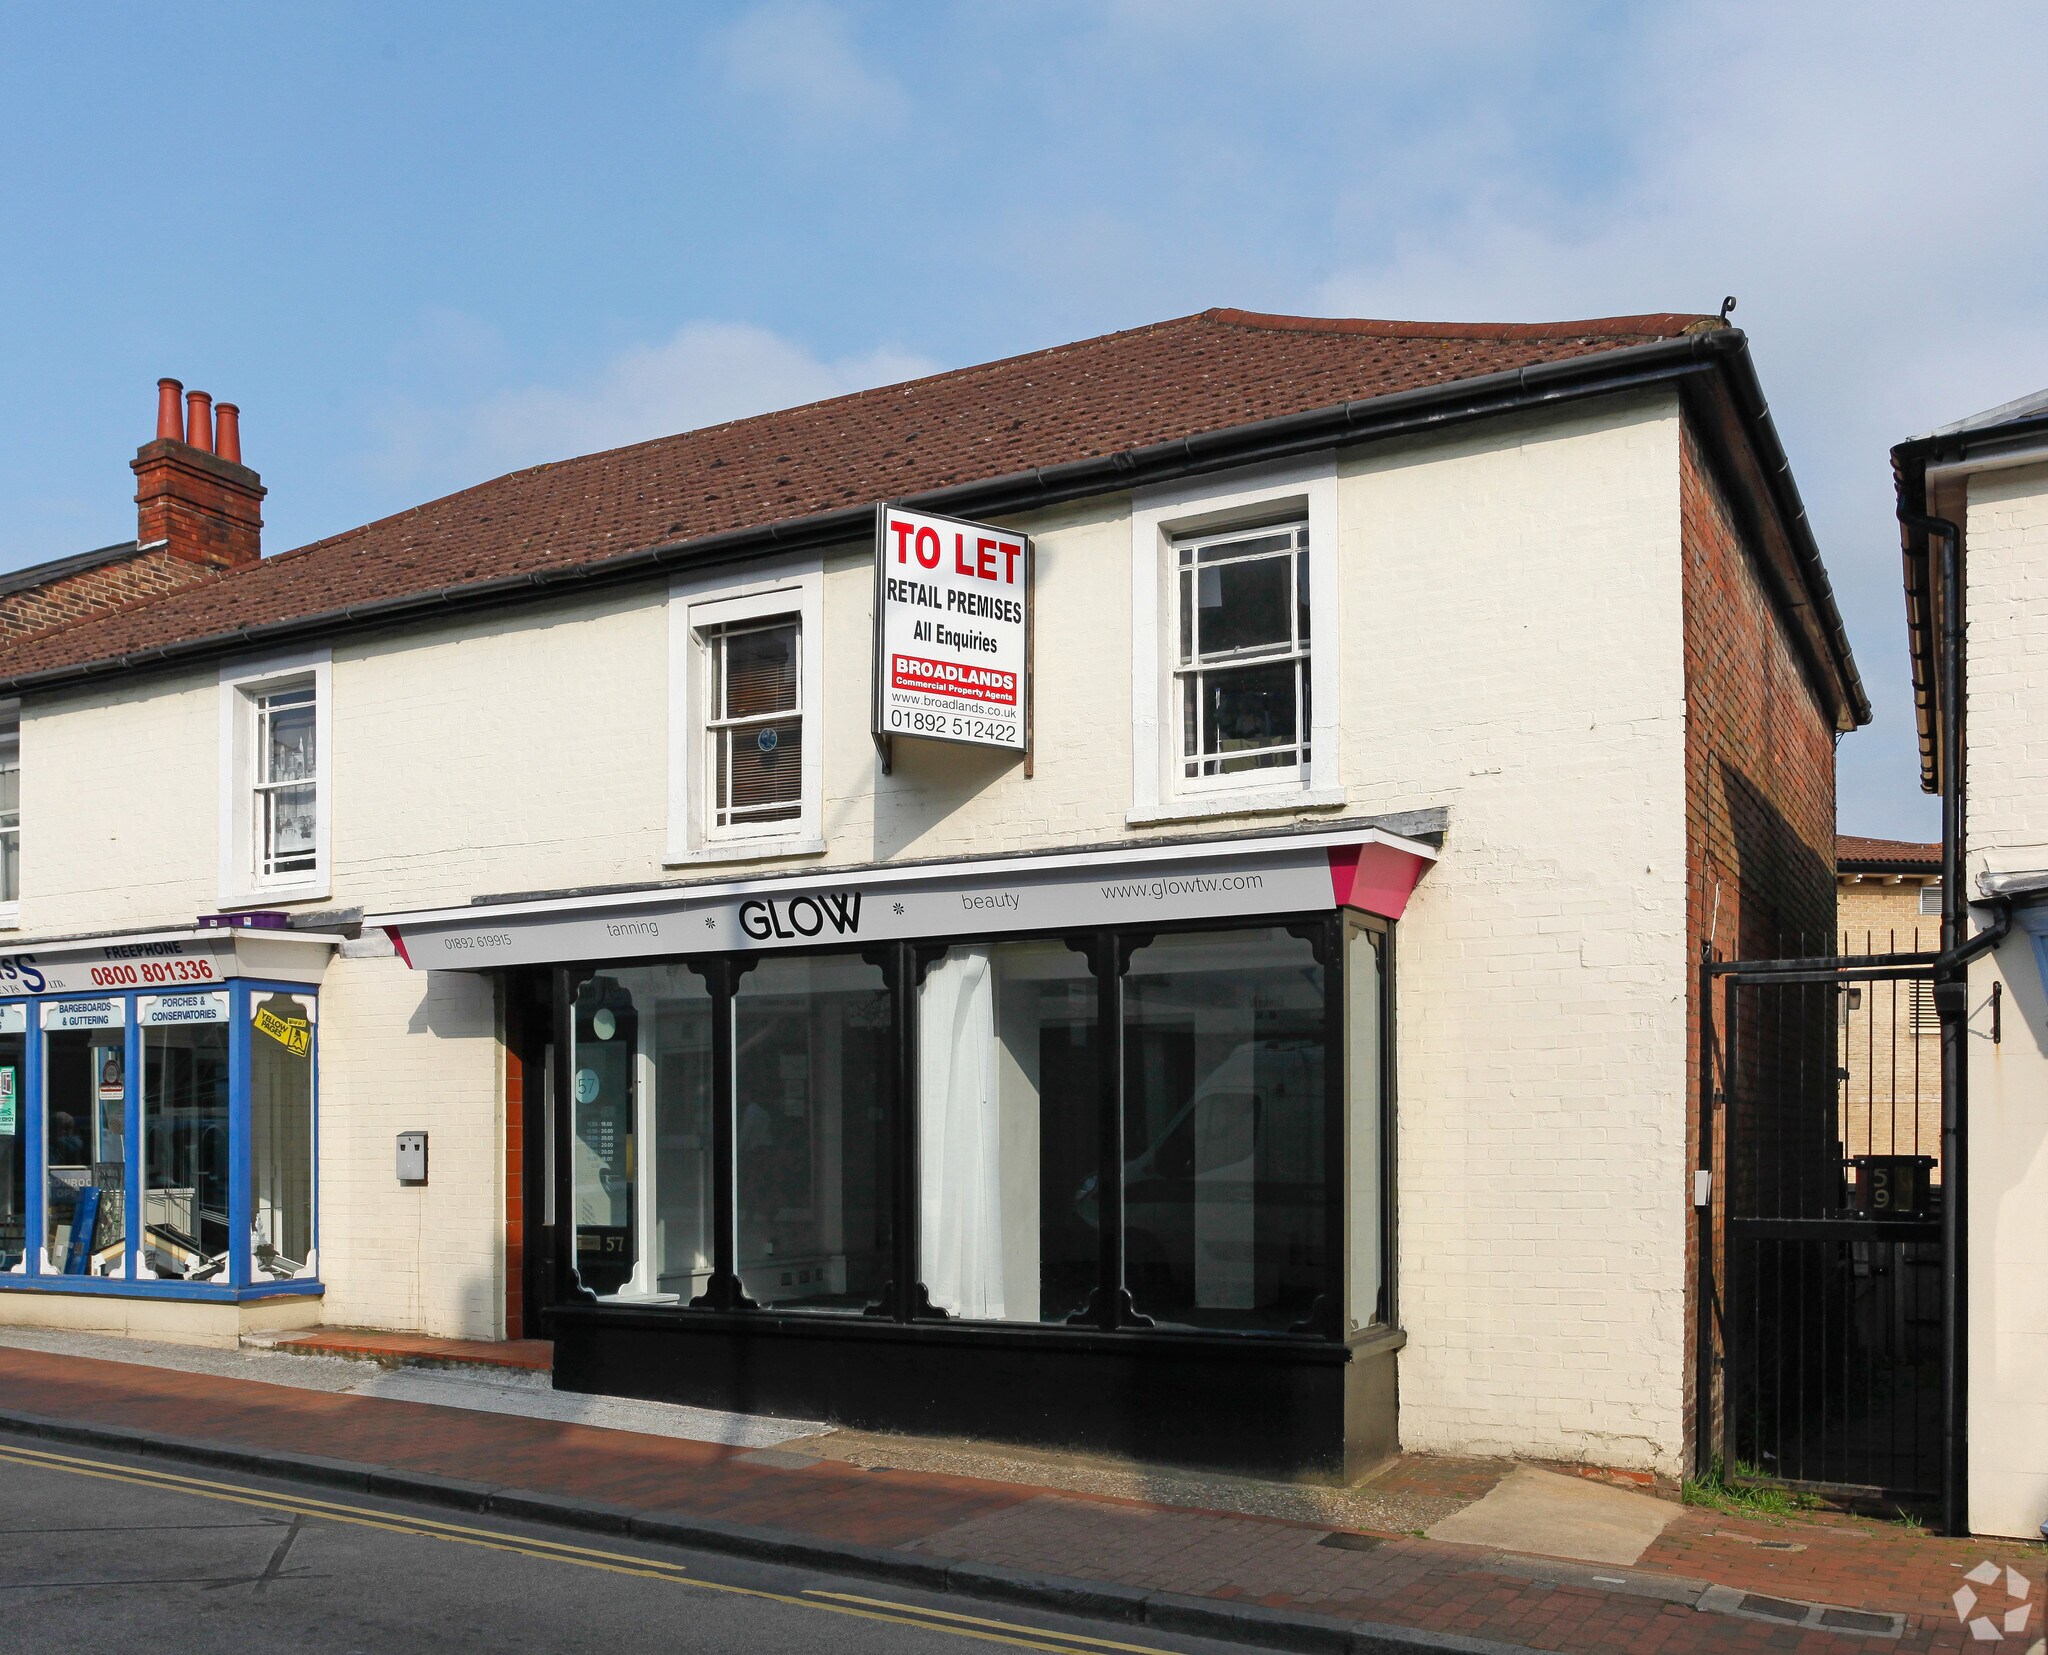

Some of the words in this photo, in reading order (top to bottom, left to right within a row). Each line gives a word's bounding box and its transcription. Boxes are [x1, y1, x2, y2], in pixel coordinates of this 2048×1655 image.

[890, 520, 941, 570] TO
[955, 533, 1021, 585] LET
[887, 577, 943, 610] RETAIL
[947, 588, 1022, 625] PREMISES
[913, 620, 932, 642] All
[936, 624, 998, 654] Enquiries
[895, 657, 1014, 691] BROADLANDS
[895, 676, 947, 692] Commercial
[948, 685, 984, 698] Property
[985, 690, 1013, 702] Agents
[891, 692, 1017, 719] www.broadlands.co.uk
[891, 709, 947, 734] 01892
[952, 718, 1016, 743] 512422
[1101, 872, 1264, 901] www.glowtw.com
[961, 891, 1020, 912] beauty
[738, 892, 862, 941] GLOW
[606, 919, 660, 939] tanning
[103, 941, 183, 960] FREEPHONE
[445, 937, 475, 950] 01892
[476, 934, 512, 948] 619915
[0, 953, 46, 993] SS
[90, 964, 138, 986] 0800
[140, 959, 213, 983] 801336
[59, 1001, 112, 1014] BARGEBOARDS
[162, 996, 198, 1008] PORCHES
[199, 996, 206, 1006] &
[62, 1016, 68, 1026] &
[69, 1015, 109, 1026] GUTTERING
[151, 1009, 217, 1021] CONSERVATORIES
[261, 1011, 289, 1034] YELLOW
[260, 1020, 282, 1037] PAGES
[578, 1077, 595, 1095] 57
[606, 1236, 625, 1252] 57
